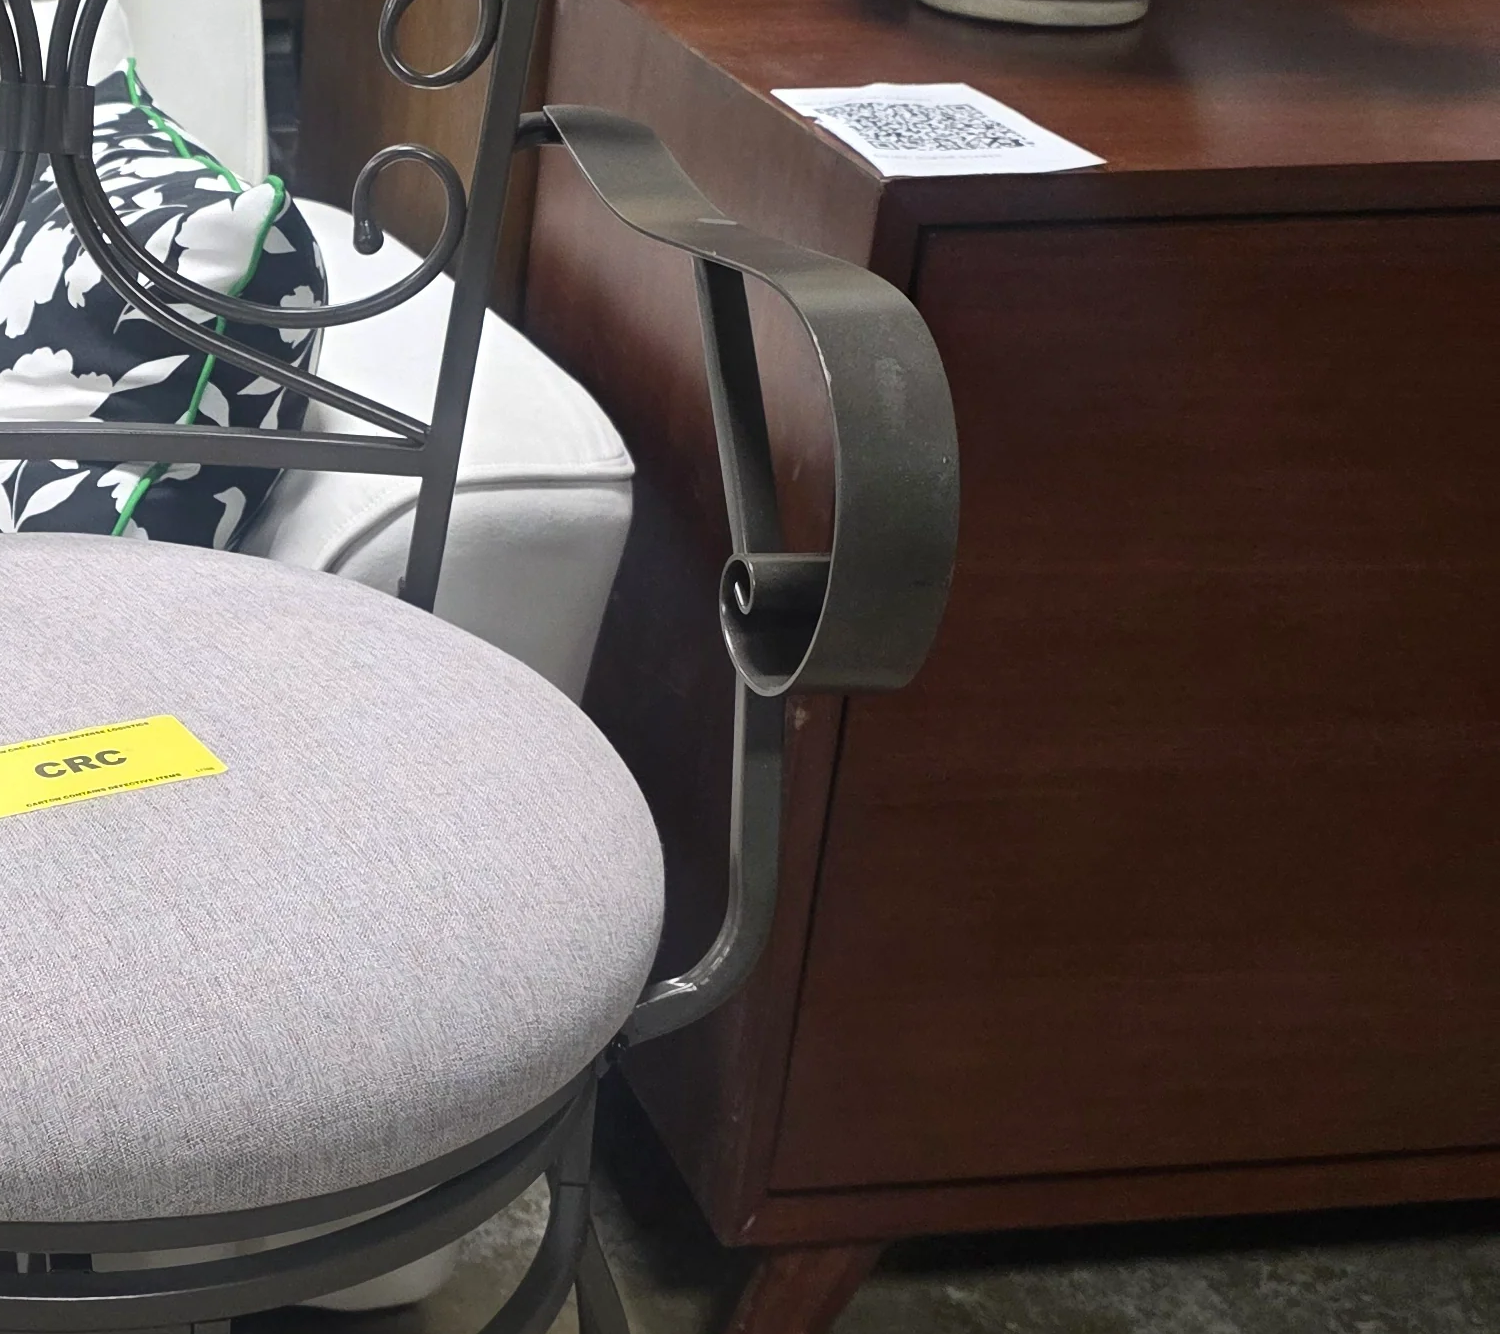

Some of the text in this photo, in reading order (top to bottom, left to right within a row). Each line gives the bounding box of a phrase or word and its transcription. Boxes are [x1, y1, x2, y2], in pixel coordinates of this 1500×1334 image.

[26, 739, 56, 748] PALLET
[69, 730, 105, 740] REVERSE
[107, 722, 149, 733] LOGISTICS
[35, 750, 127, 778] CRC
[26, 772, 182, 808] CARTON CONTAINS DEFECTIVE ITEMS
